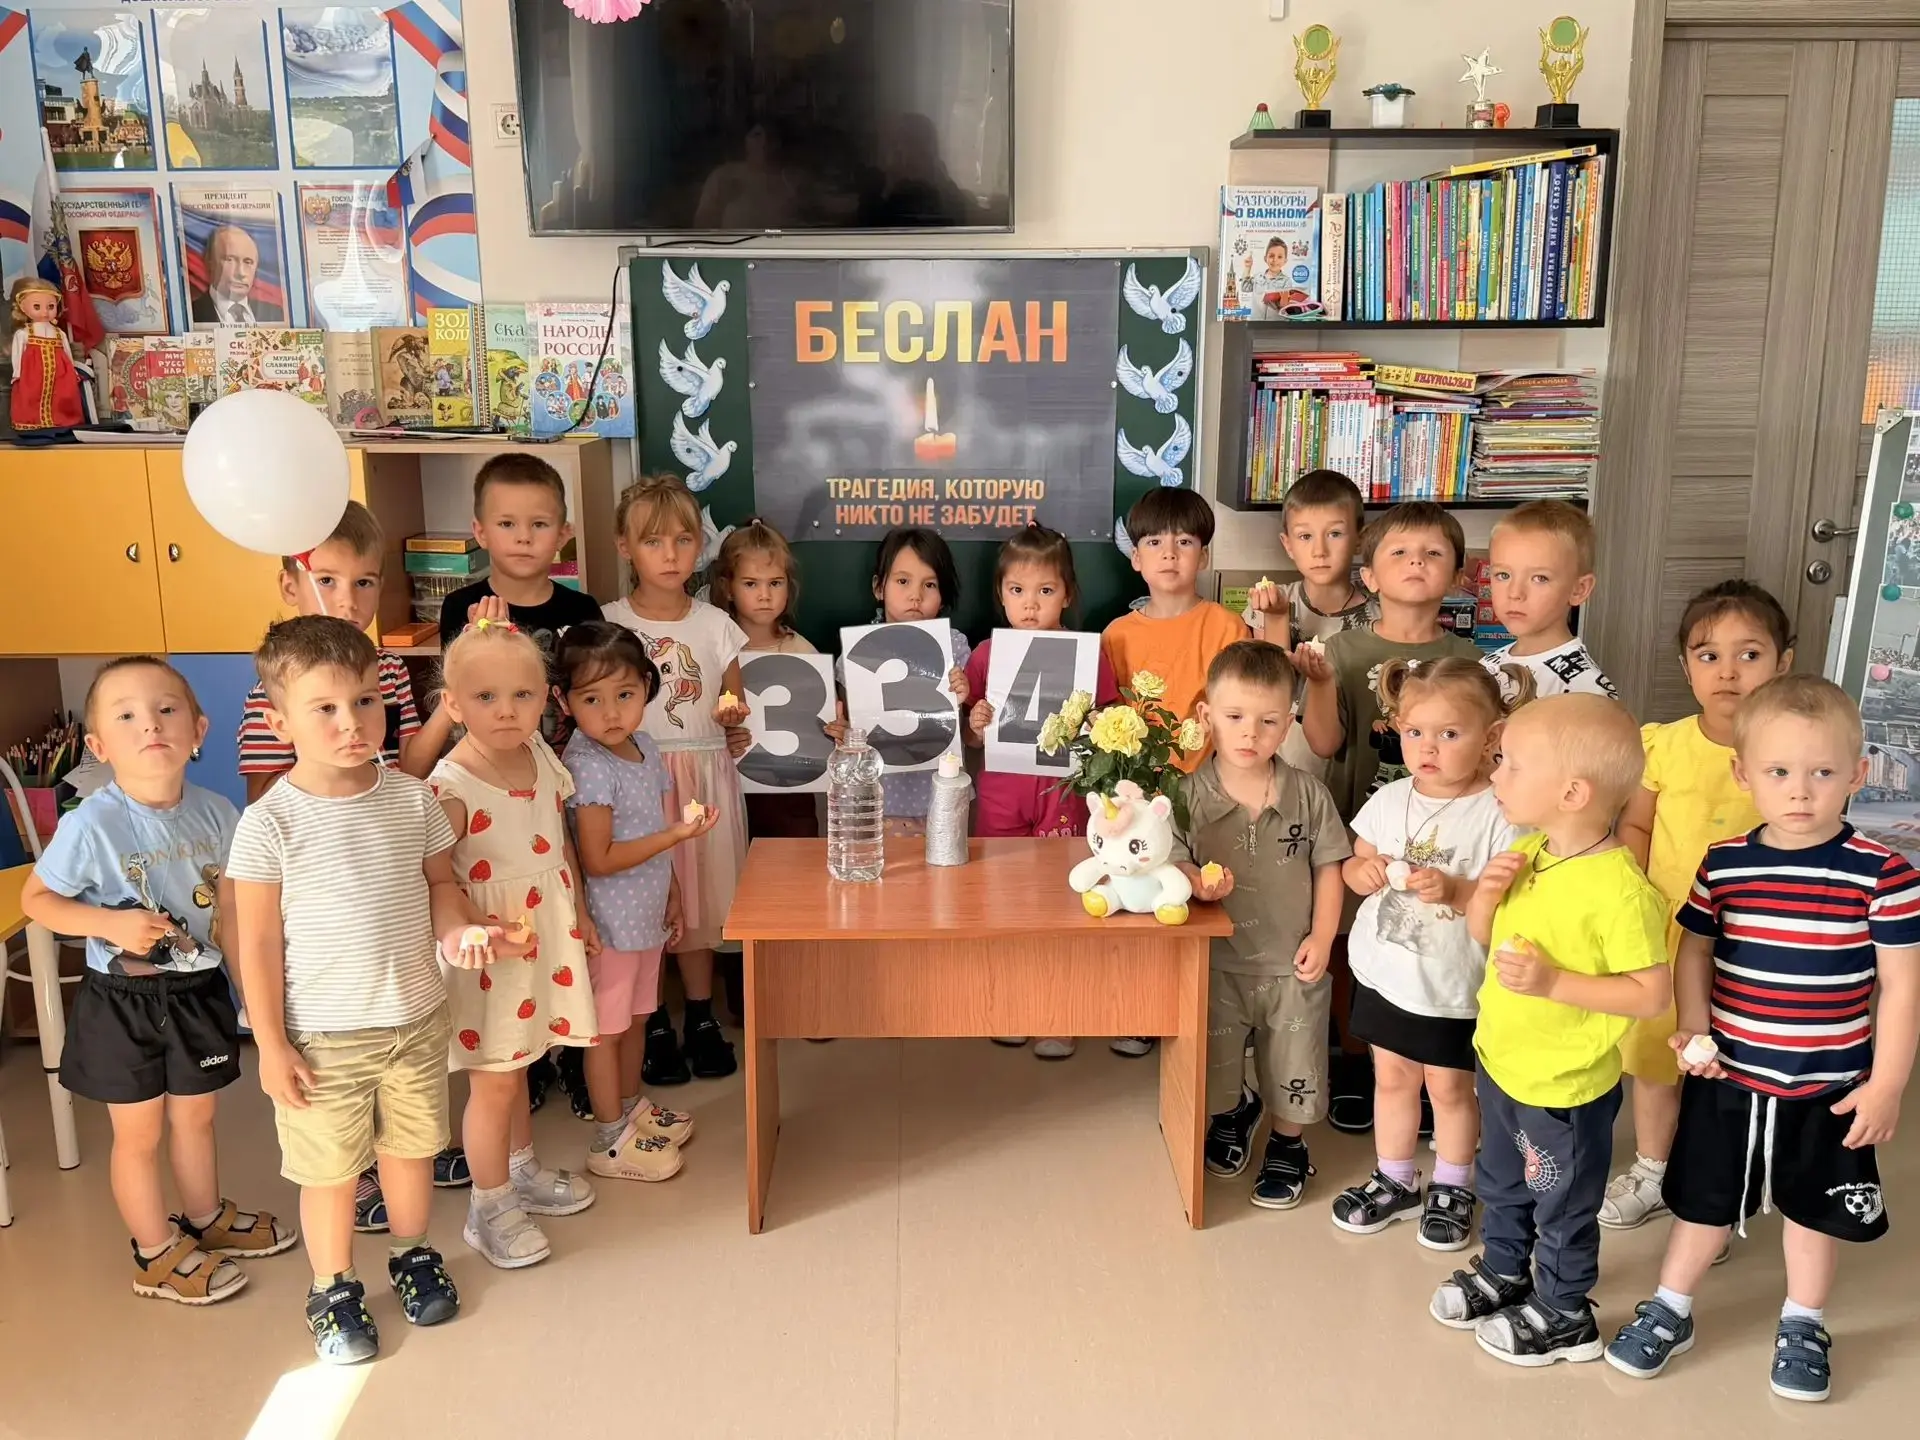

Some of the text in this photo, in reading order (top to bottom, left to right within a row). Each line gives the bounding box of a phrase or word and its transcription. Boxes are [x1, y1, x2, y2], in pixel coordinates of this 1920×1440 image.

[1235, 195, 1307, 206] РАЗГОВОРЫ
[1235, 208, 1307, 219] О ВАЖНОМ
[543, 325, 615, 340] НАРОДЫ
[795, 300, 1068, 363] БЕСЛАН
[544, 342, 615, 356] РОССИИ
[825, 478, 1045, 502] ТРАГЕДИЯ, КОТОРУЮ
[835, 504, 1037, 528] НИКТО НЕ ЗАБУДЕТ
[847, 624, 957, 766] 3
[998, 636, 1078, 768] 4
[737, 654, 837, 788] 3
[199, 1054, 229, 1068] adidas
